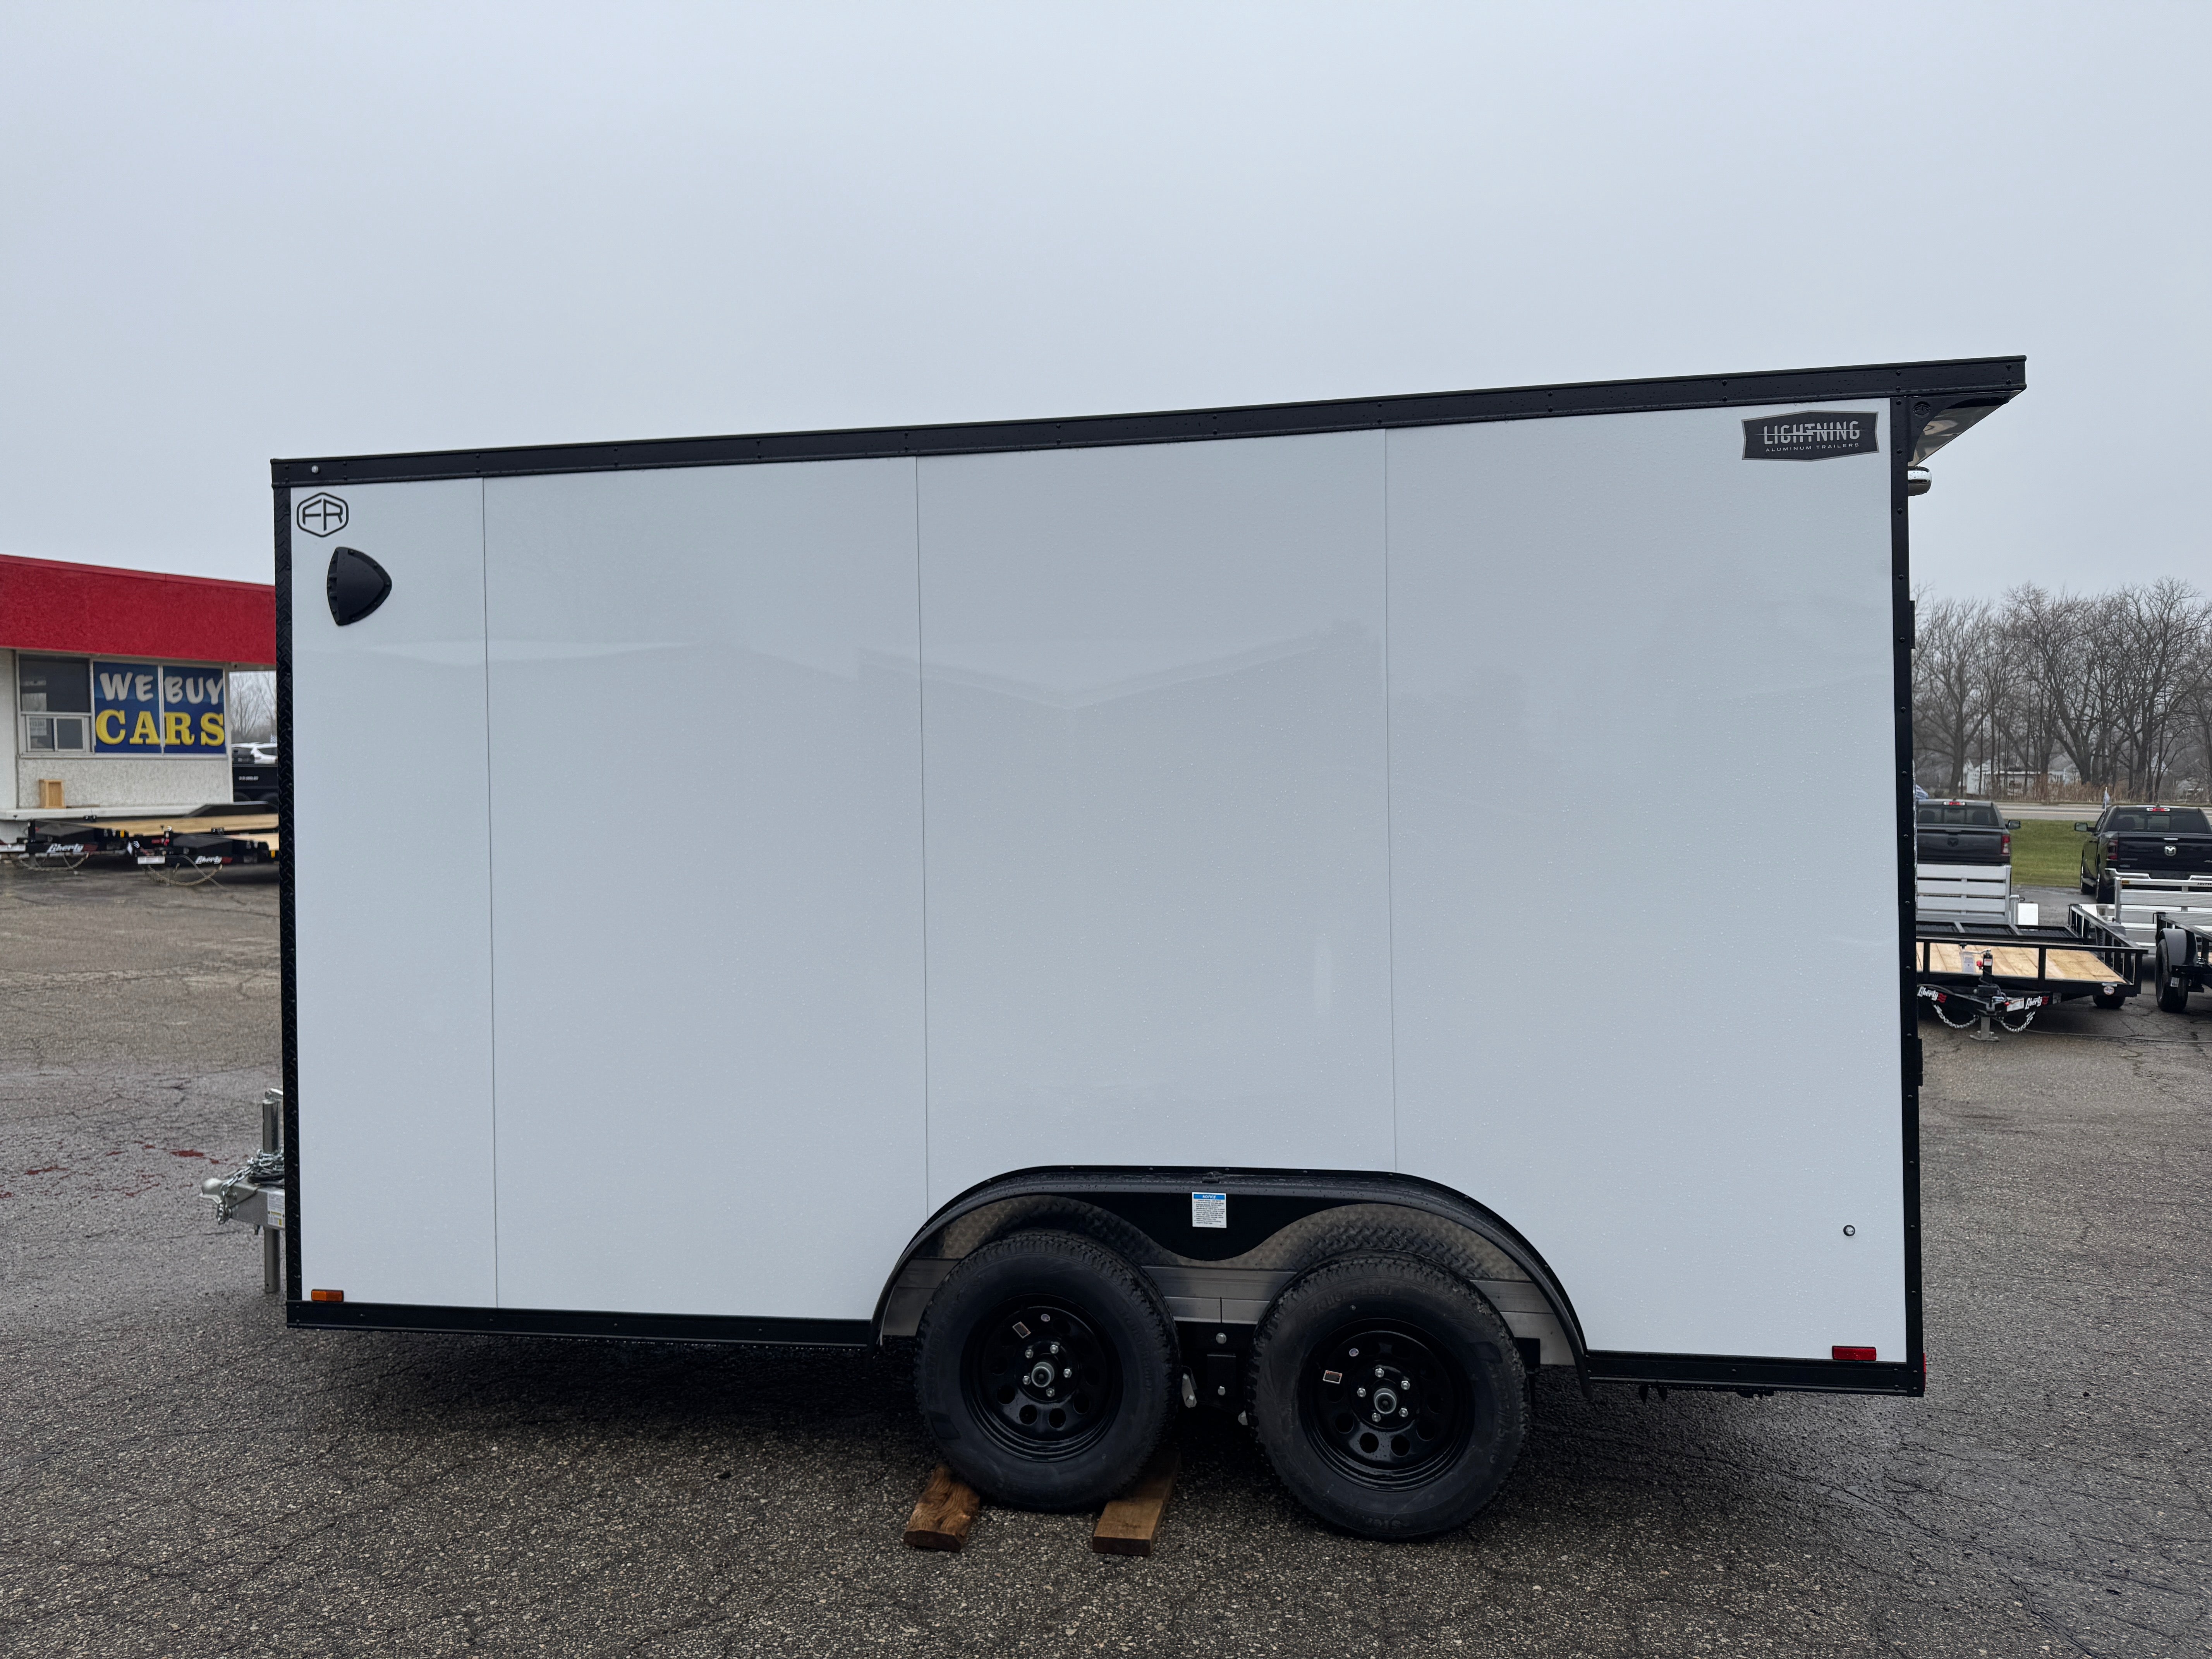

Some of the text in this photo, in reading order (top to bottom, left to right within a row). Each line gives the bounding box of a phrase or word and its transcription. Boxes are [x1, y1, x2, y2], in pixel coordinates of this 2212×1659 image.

[1764, 421, 1860, 445] LIGHTNING
[100, 672, 223, 705] WE BUY
[96, 709, 225, 746] CARS
[46, 843, 84, 854] Liberty
[1917, 986, 1939, 1001] Liberty
[2025, 996, 2042, 1010] Liberty
